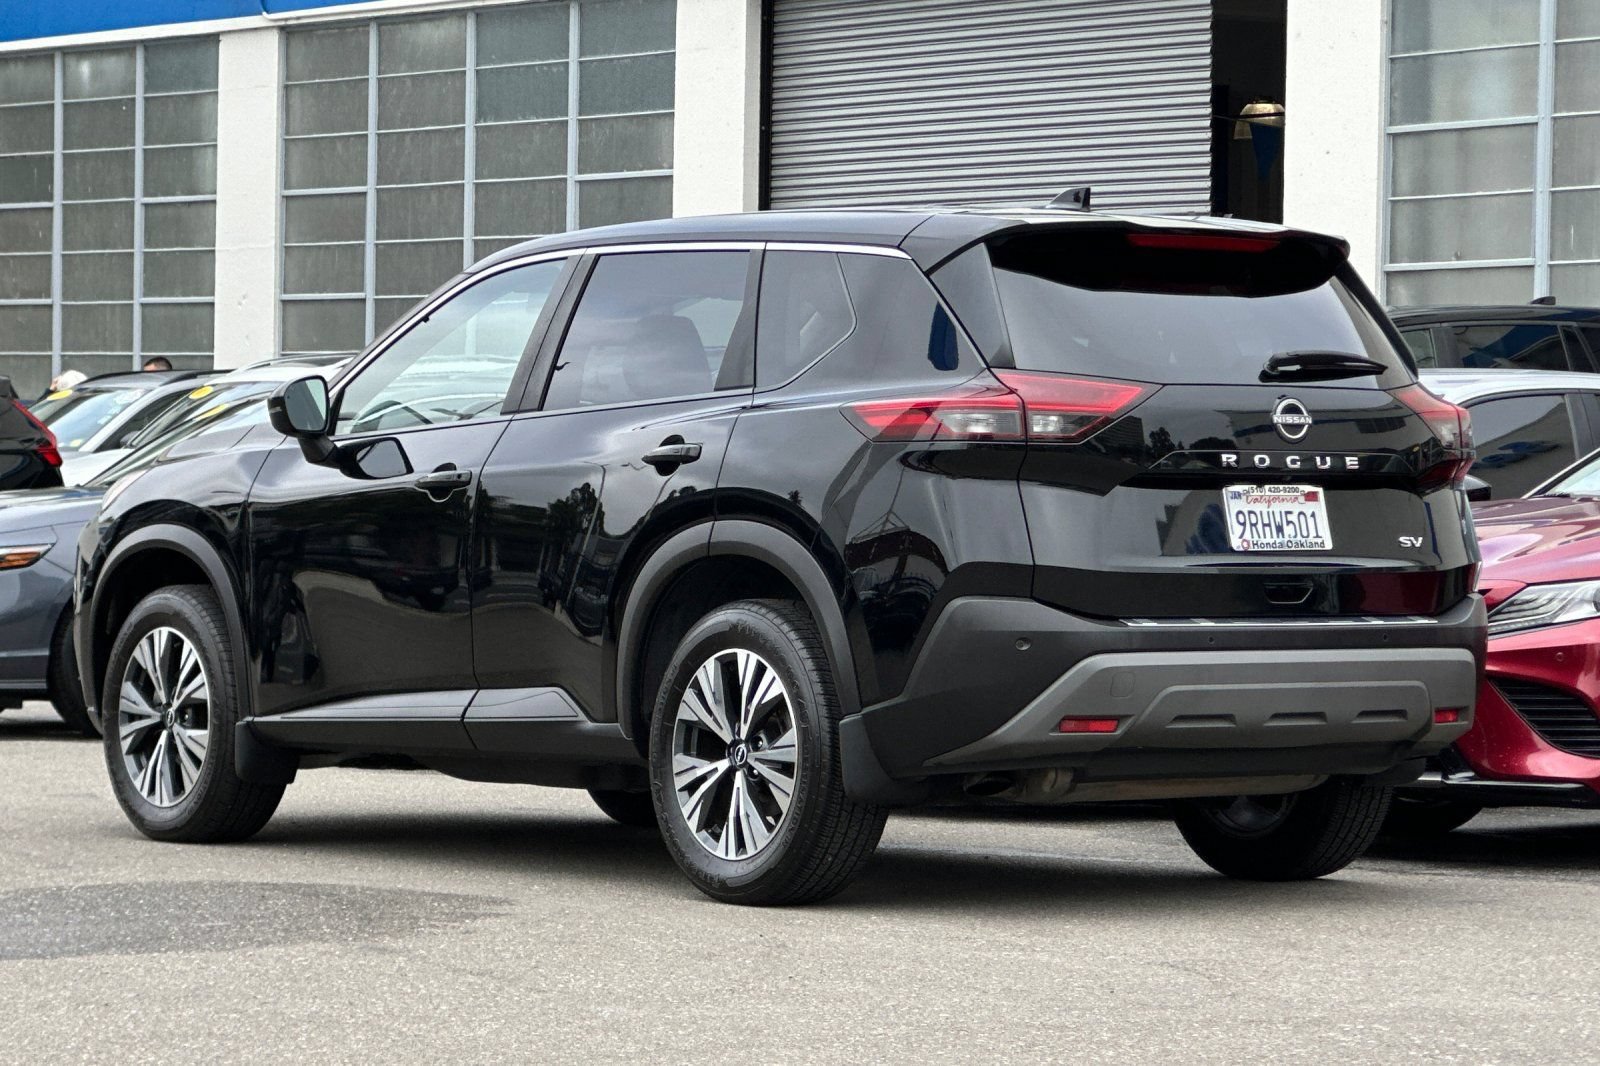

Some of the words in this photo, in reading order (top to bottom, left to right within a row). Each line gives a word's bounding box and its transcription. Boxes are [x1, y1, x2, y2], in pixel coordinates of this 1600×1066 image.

[1273, 416, 1312, 424] NISSAN
[1221, 454, 1359, 469] ROGUE
[1246, 496, 1299, 508] California
[1235, 510, 1322, 539] 9RHW501
[1252, 541, 1283, 549] Honda
[1287, 540, 1325, 549] Oakland
[1399, 536, 1423, 547] SV
